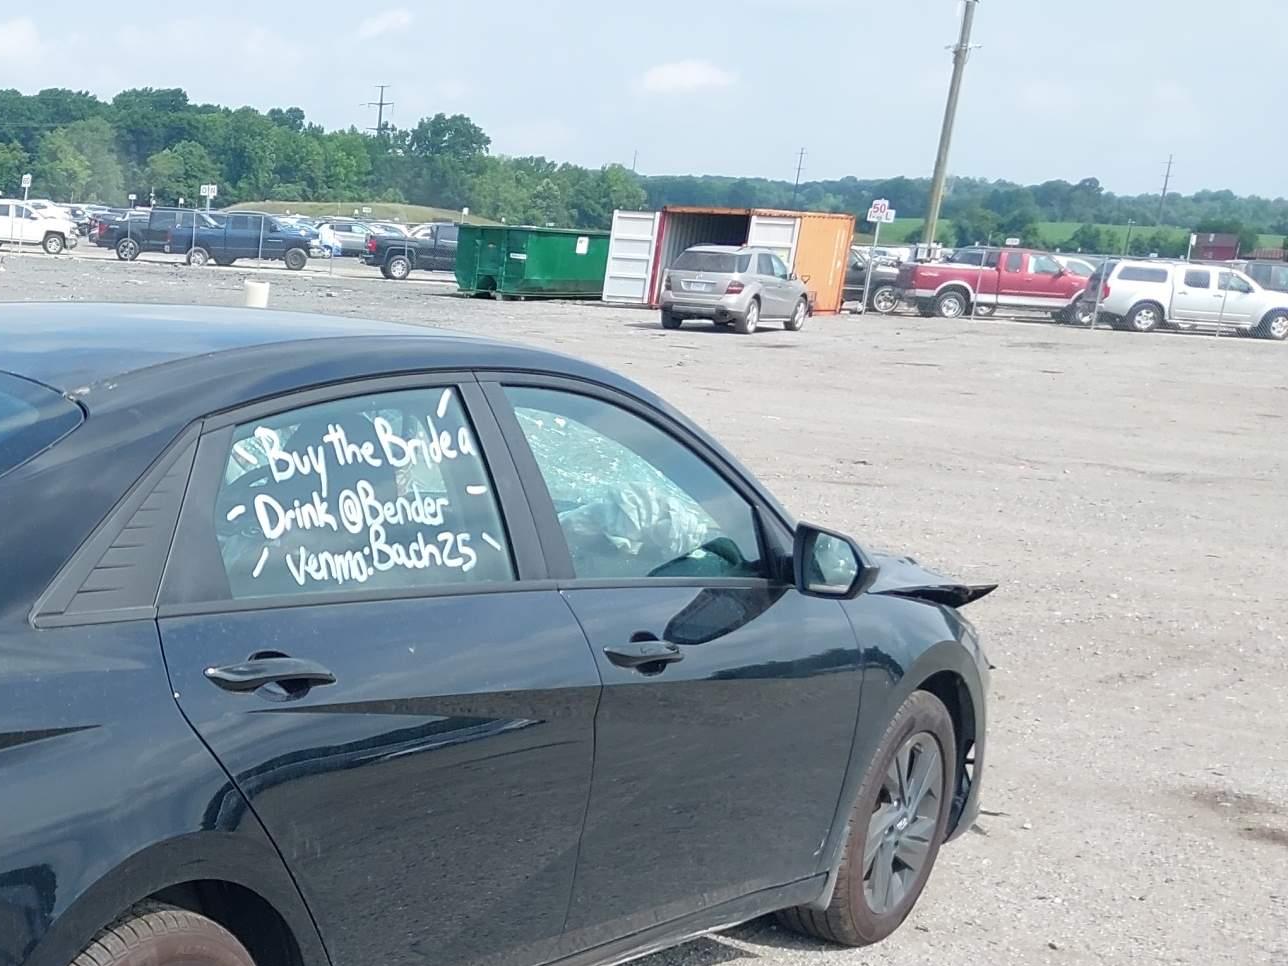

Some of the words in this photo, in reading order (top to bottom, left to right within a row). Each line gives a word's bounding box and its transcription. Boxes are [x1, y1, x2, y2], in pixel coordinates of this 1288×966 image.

[872, 203, 887, 214] 50
[254, 425, 328, 498] Buy
[323, 423, 382, 467] the
[374, 416, 457, 469] Bride
[254, 491, 338, 539] Drink
